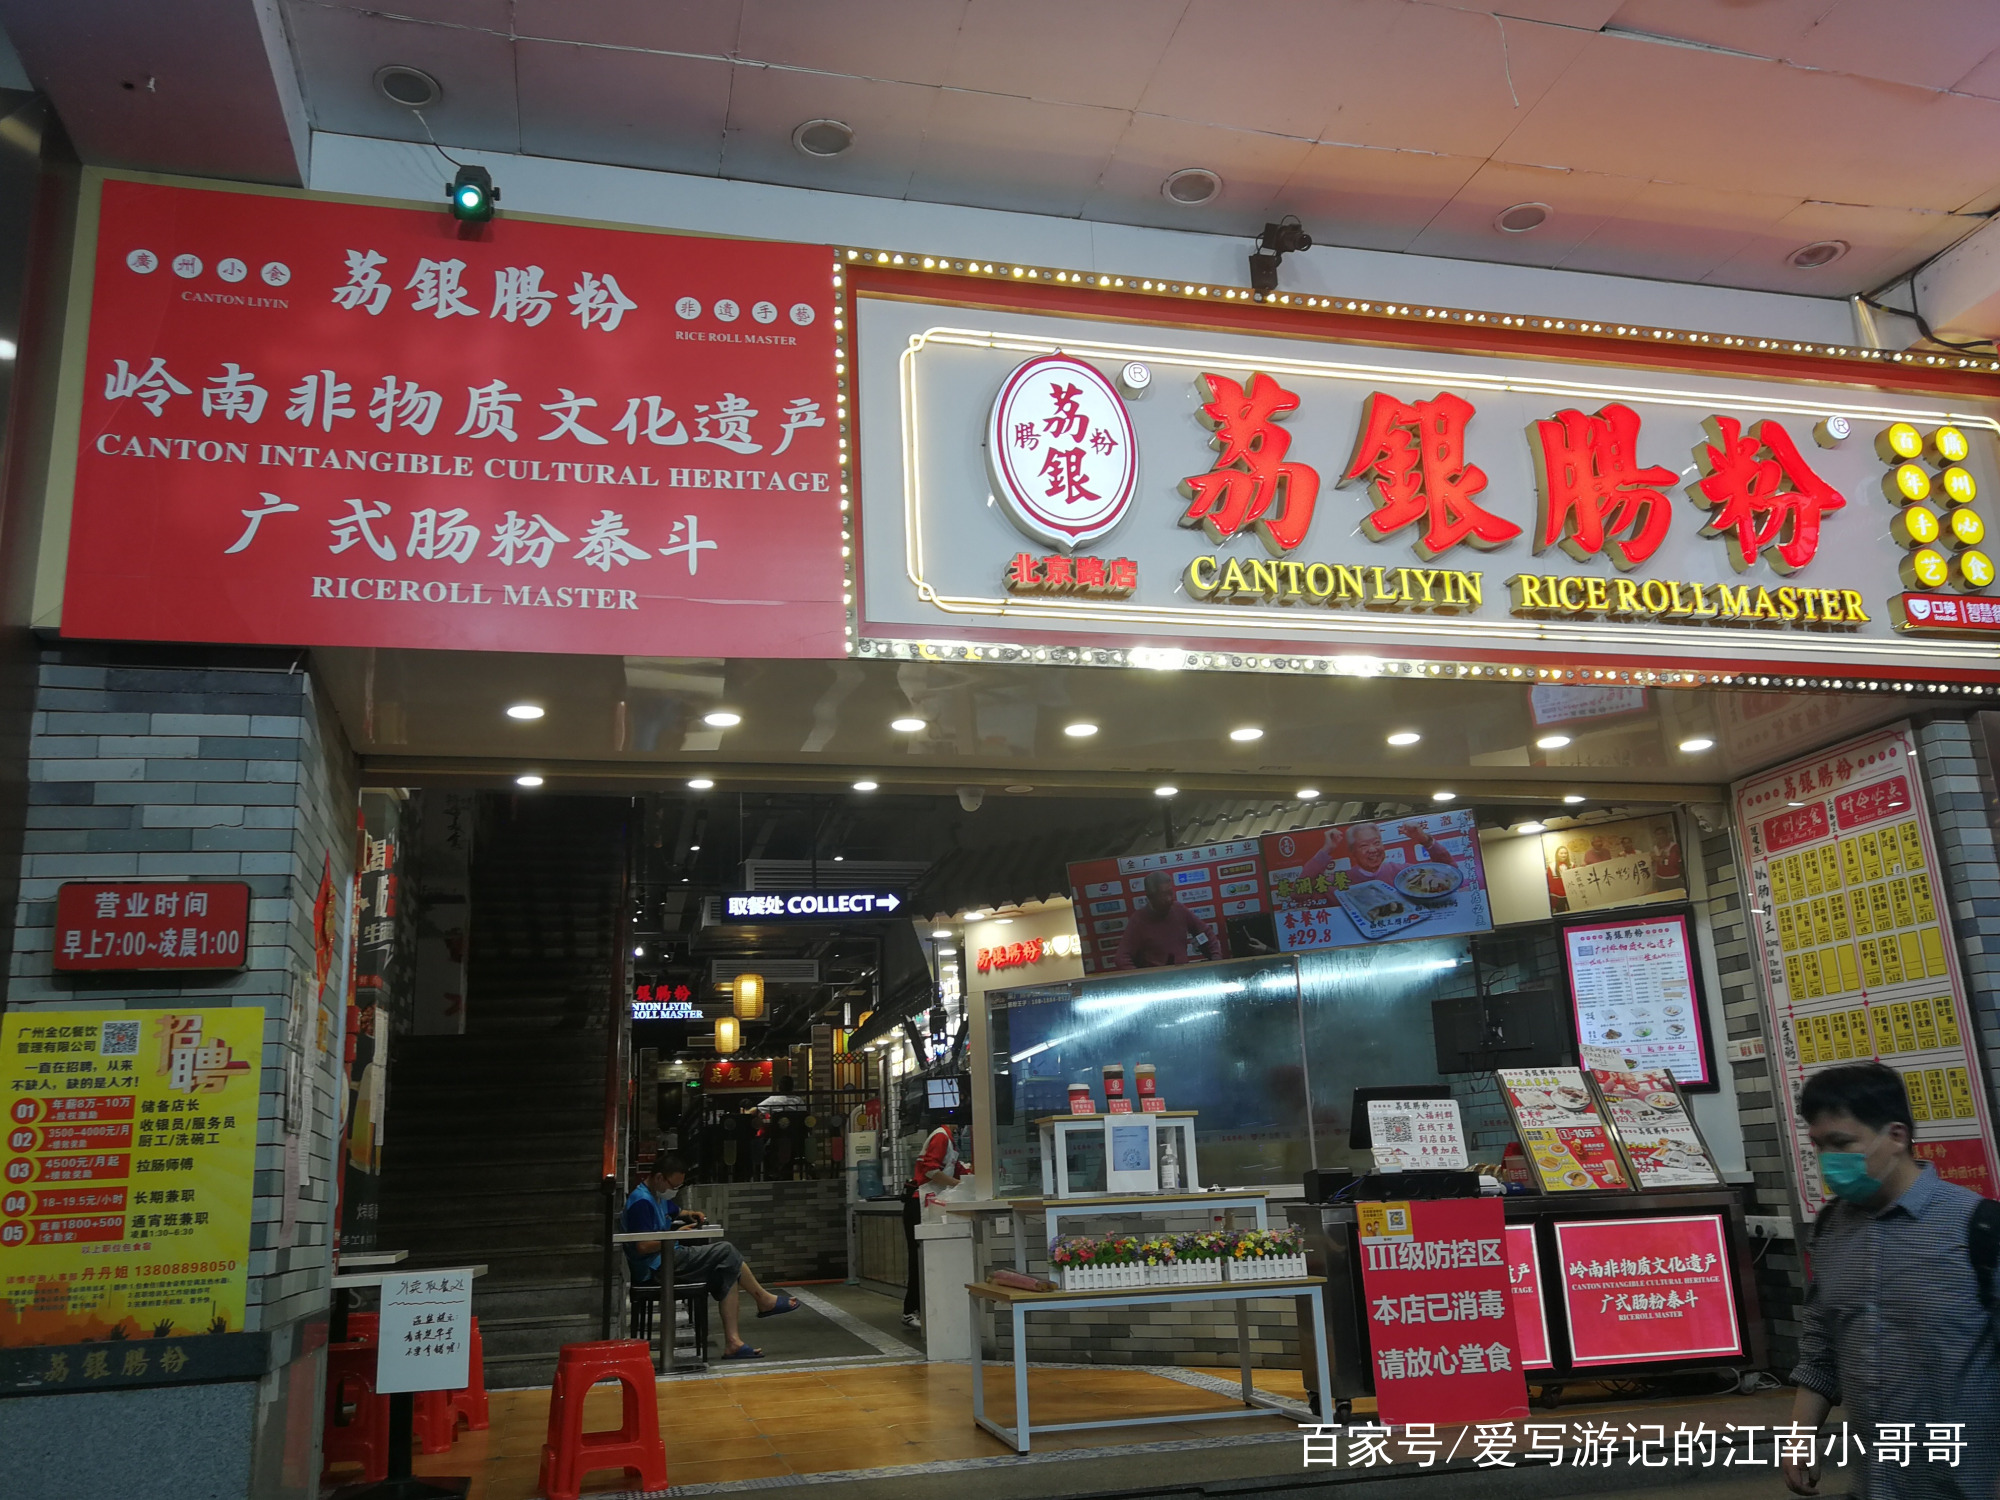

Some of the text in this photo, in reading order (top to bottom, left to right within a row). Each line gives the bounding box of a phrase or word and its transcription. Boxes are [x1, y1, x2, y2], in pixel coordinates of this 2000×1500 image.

[331, 248, 638, 332] 荔銀腸粉
[181, 290, 289, 310] CANTON LIYIN
[675, 331, 797, 346] RICE ROLL MASTER
[103, 357, 827, 457] 岭南非物质文化遗产
[96, 433, 831, 494] CANTON INTANGIBLE CULTURAL HERITAGE
[1182, 370, 1848, 571] 荔銀腸粉
[224, 492, 718, 576] 广式肠粉泰斗
[1010, 552, 1139, 590] 北京路店
[1190, 555, 1484, 606] CANTON LIYIN
[311, 575, 639, 611] RICEROLL MASTER
[1519, 574, 1870, 623] RICE ROLL MASTER
[95, 891, 209, 919] 营业时间
[728, 894, 875, 915] 取餐处 COLLECT
[1284, 909, 1332, 929] 套餐价
[62, 928, 240, 960] 早上7:00~凌晨1:00
[1288, 928, 1332, 948] ¥29.8
[661, 1010, 704, 1020] MASTER
[17, 1026, 98, 1039] 广州金亿餐饮
[17, 1040, 97, 1054] 管理有限公司
[153, 1014, 251, 1094] 招聘
[16, 1103, 36, 1118] 01
[141, 1099, 200, 1113] 储备店长
[139, 1116, 236, 1132] 收银员/服务员
[1416, 1111, 1454, 1120] 入福利群
[1418, 1123, 1455, 1132] 在线下单
[12, 1132, 33, 1147] 02
[138, 1132, 220, 1148] 厨工/洗碗工
[1419, 1134, 1458, 1144] 到店自取
[9, 1163, 30, 1178] 03
[45, 1155, 120, 1169] 4500元/月起
[136, 1157, 194, 1172] 拉肠师傅
[5, 1196, 26, 1211] 04
[133, 1189, 195, 1205] 长期兼职
[131, 1211, 209, 1228] 通宵班兼职
[2, 1226, 24, 1241] 05
[81, 1265, 128, 1281] 丹丹姐
[134, 1260, 236, 1277] 13808898050
[1569, 1253, 1717, 1279] 岭南非物质文化遗产
[1572, 1275, 1720, 1291] CANTON INTANGIBLE CULTURAL HERITAGE
[1372, 1289, 1506, 1326] 本店已消毒
[1600, 1290, 1699, 1314] 广式肠粉泰斗
[1618, 1310, 1683, 1321] RICEROLL MASTER
[1378, 1342, 1513, 1380] 请放心堂食
